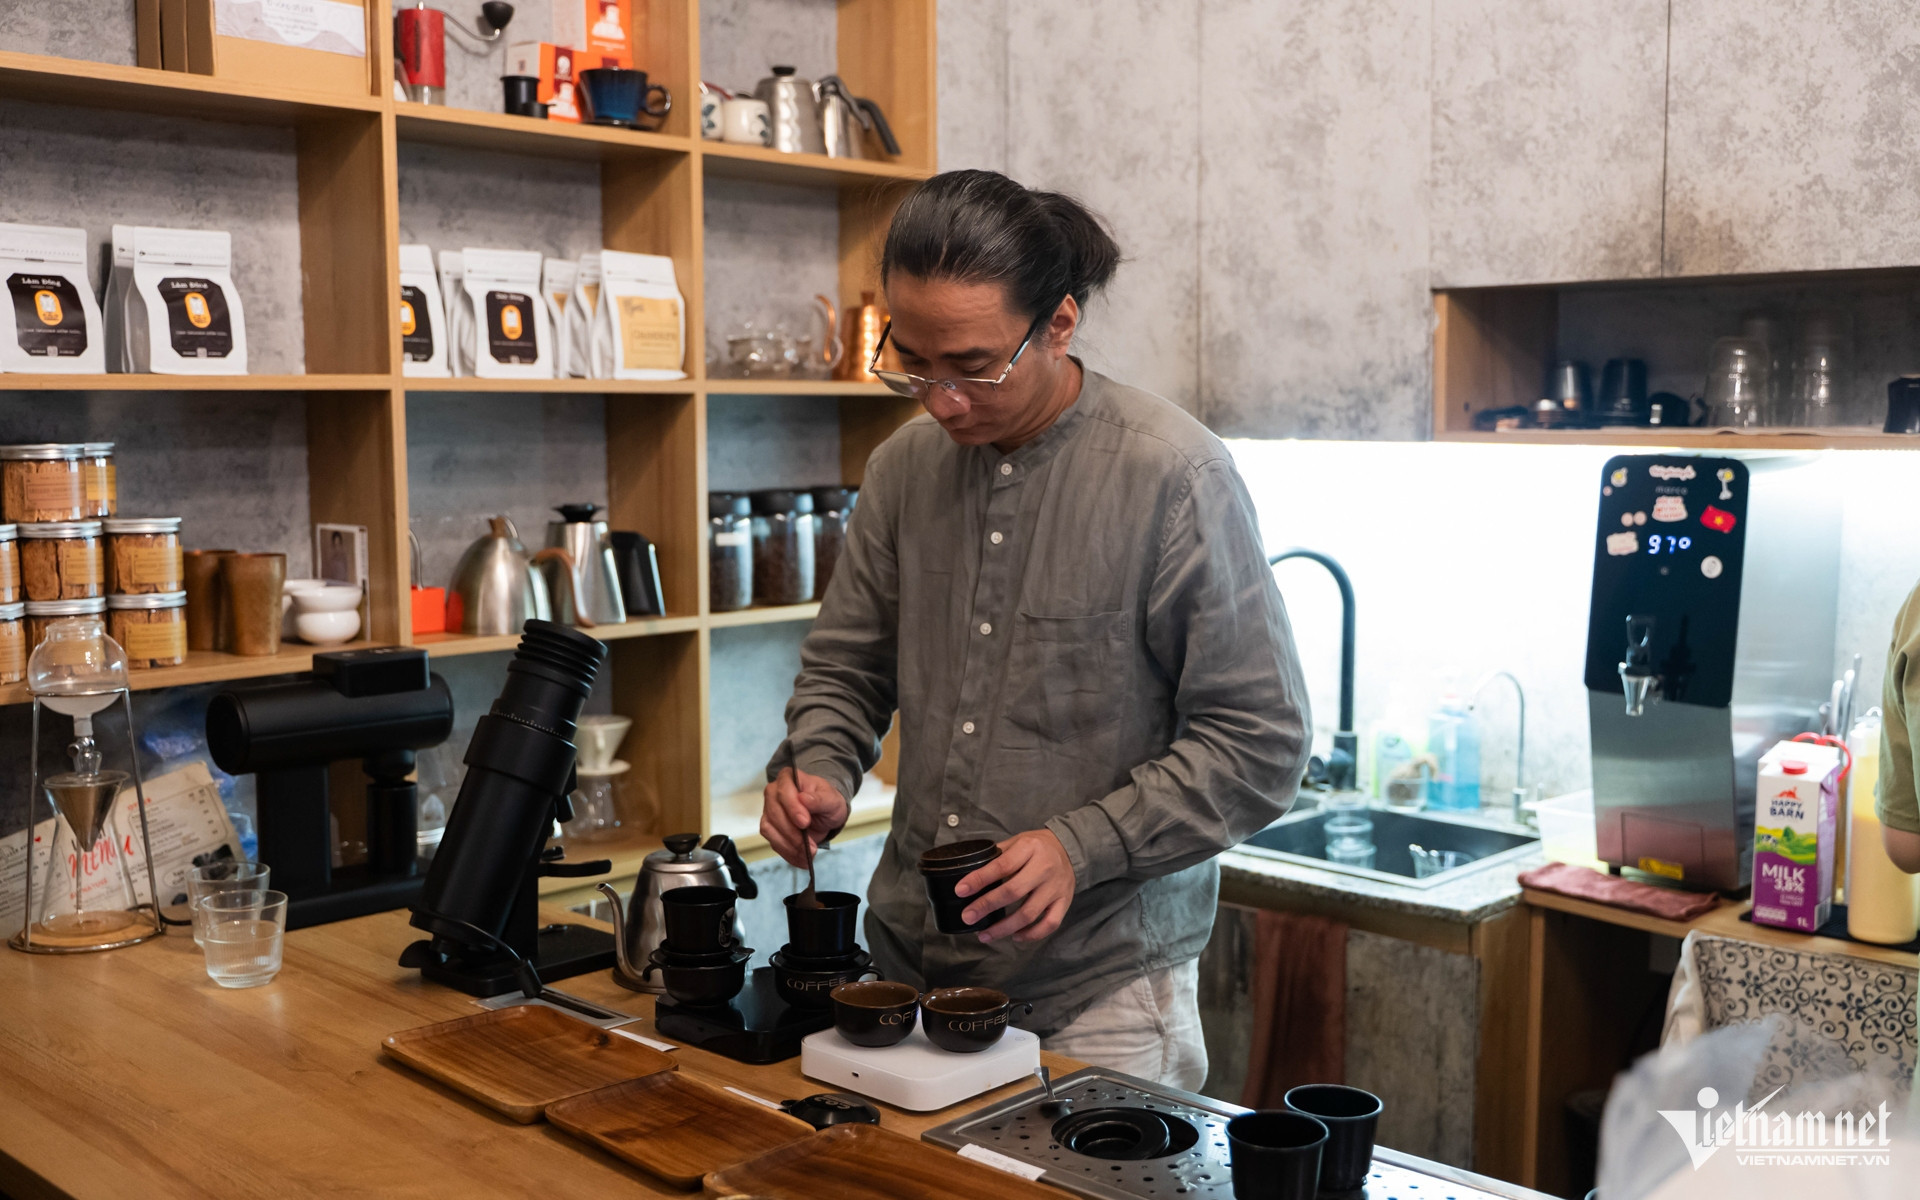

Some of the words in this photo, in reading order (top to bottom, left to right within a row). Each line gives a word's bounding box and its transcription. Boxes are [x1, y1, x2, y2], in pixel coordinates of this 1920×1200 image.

[1771, 799, 1804, 809] HAPPY
[1769, 806, 1805, 820] BARN
[1762, 862, 1805, 884] MILK
[786, 976, 848, 991] COFFEE
[948, 1012, 1008, 1032] COFFEE
